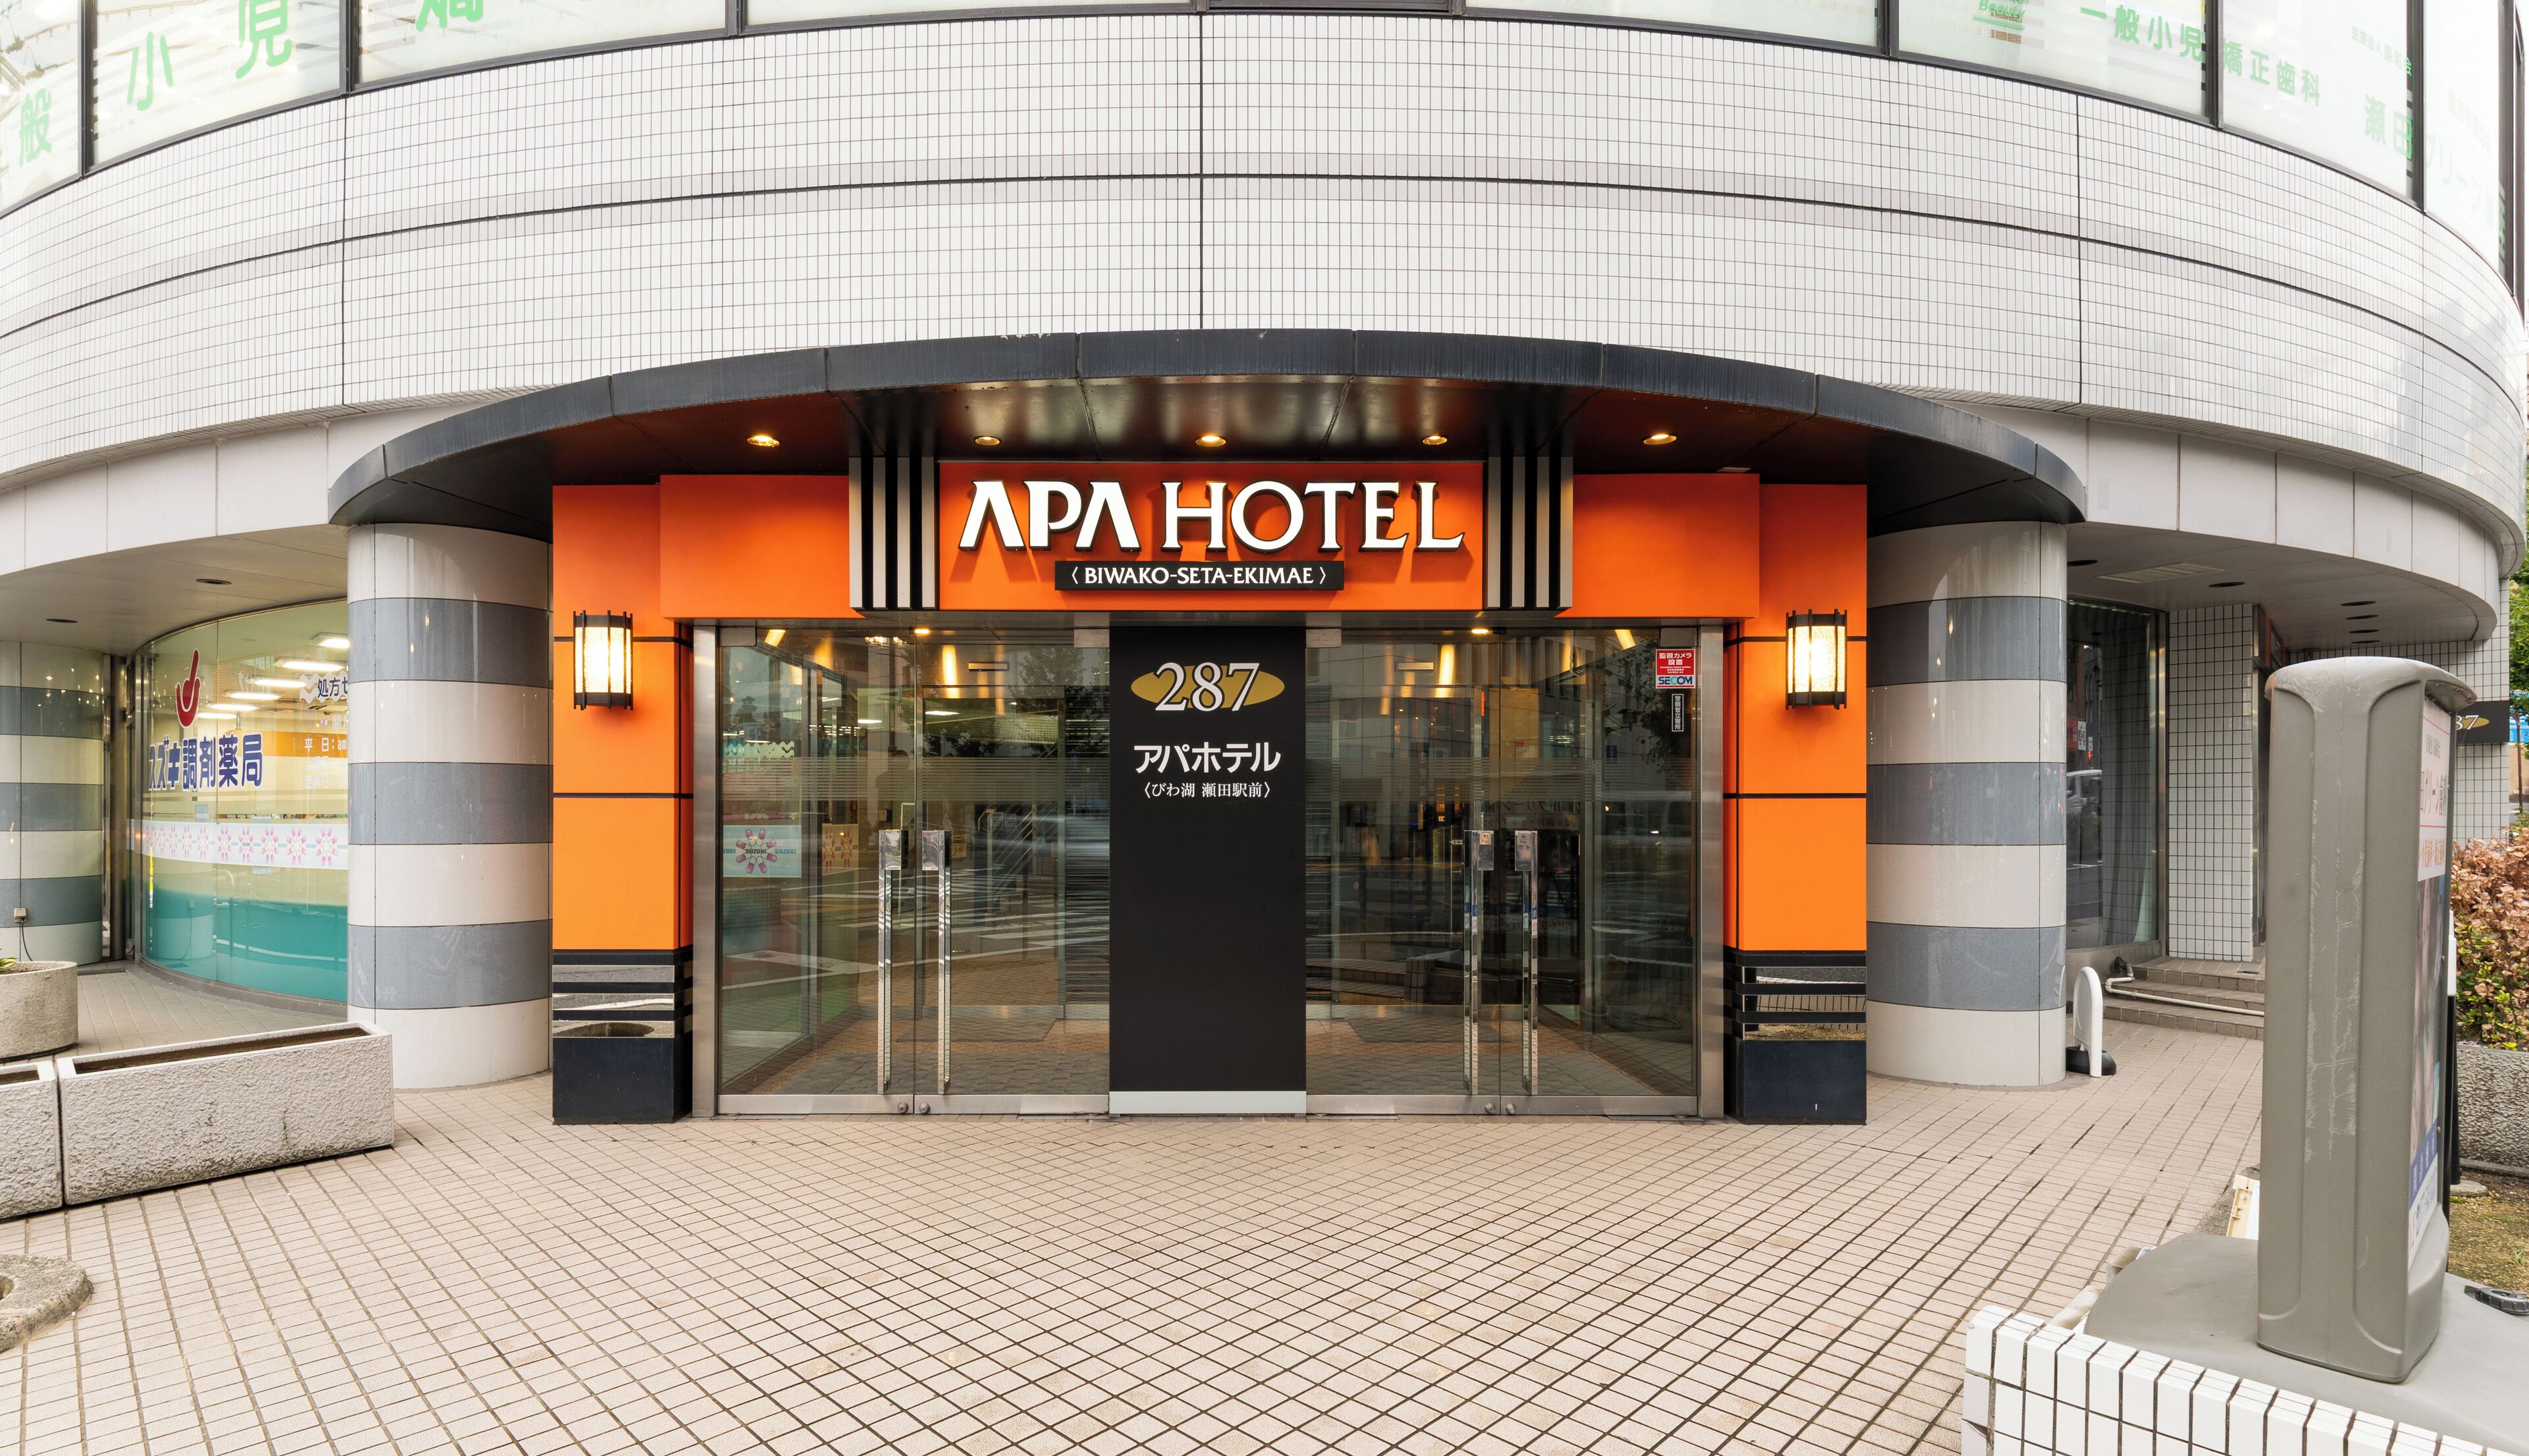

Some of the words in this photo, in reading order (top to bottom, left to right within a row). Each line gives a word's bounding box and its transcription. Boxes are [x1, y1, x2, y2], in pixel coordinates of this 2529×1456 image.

[958, 480, 1141, 551] APA
[1160, 480, 1465, 553] HOTEL
[1155, 661, 1260, 712] 287
[1658, 676, 1693, 685] SECOM
[149, 734, 262, 791] スズキ調剤薬局
[1133, 741, 1282, 773] アパホテル
